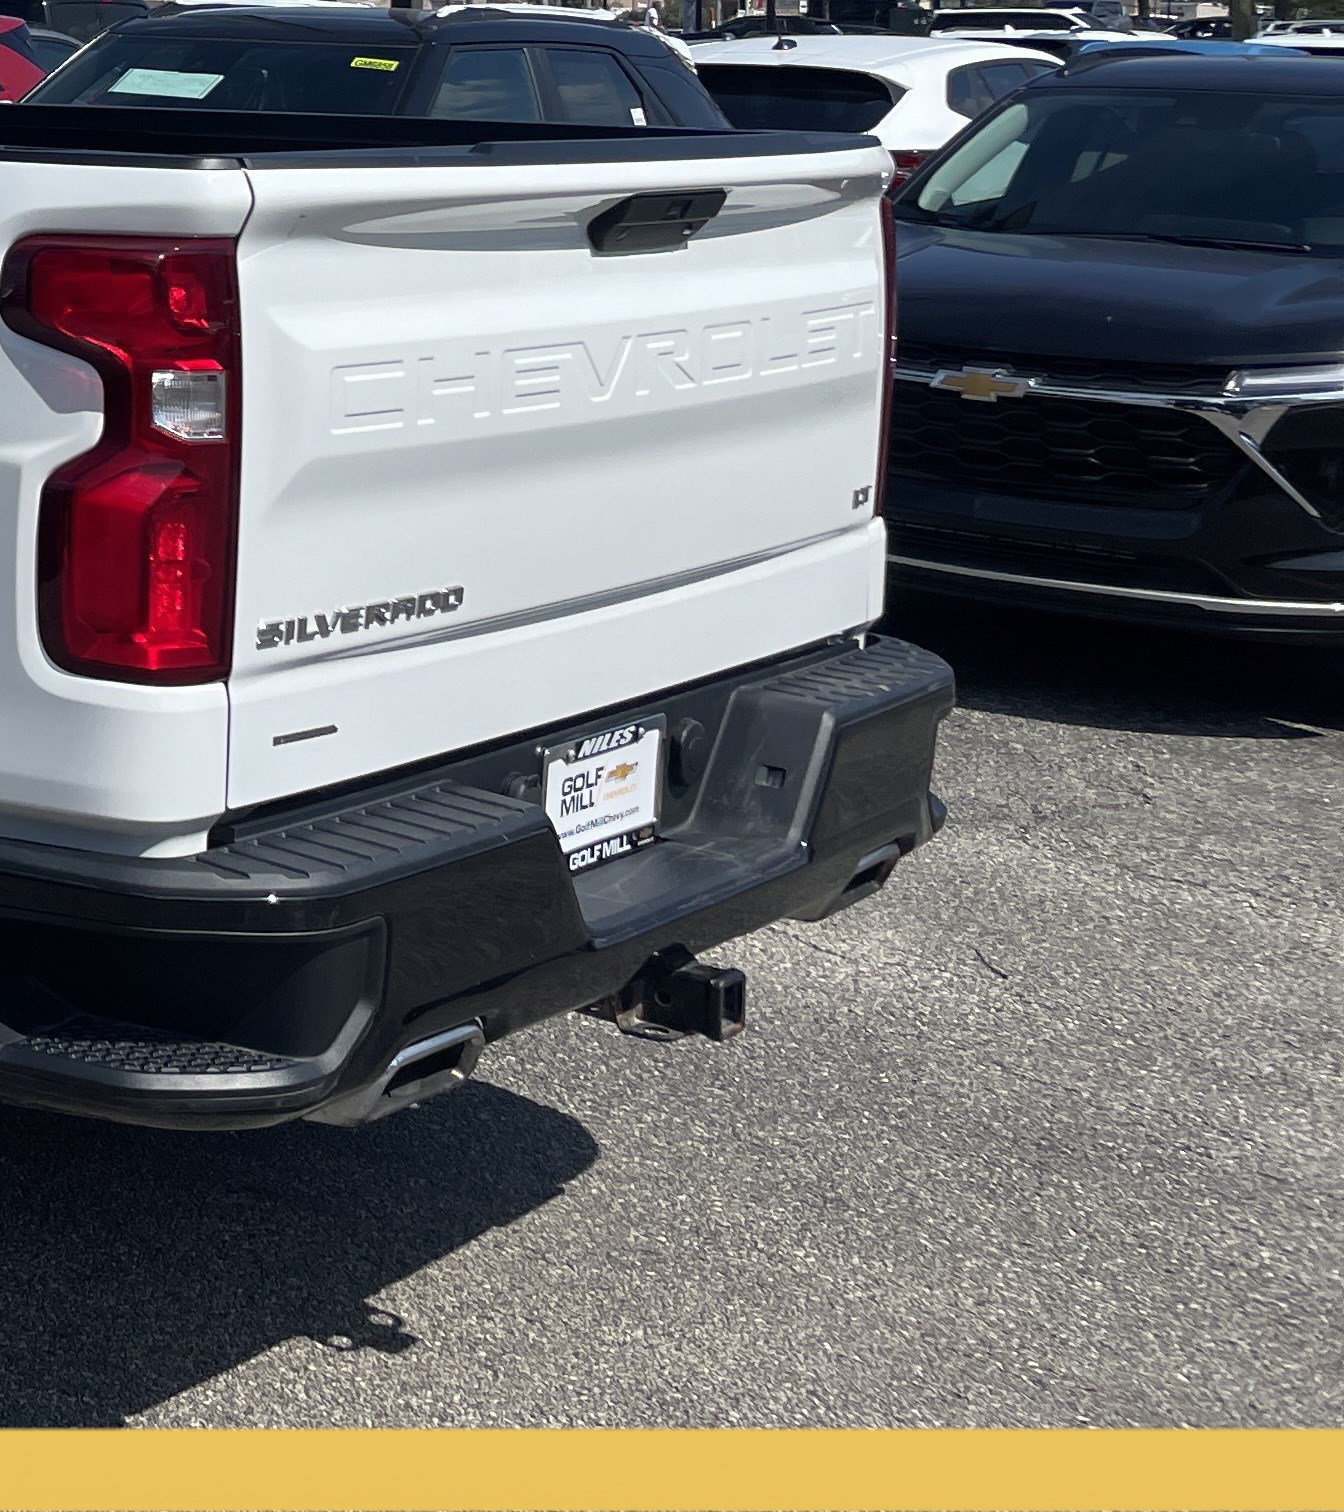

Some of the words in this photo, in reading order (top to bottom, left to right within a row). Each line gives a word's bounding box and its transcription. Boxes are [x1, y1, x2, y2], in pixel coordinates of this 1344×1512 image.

[330, 301, 875, 434] CHEVROLET
[255, 586, 465, 650] SILVERADO
[577, 725, 636, 759] NILES
[562, 765, 605, 797] GOLF
[560, 790, 595, 818] MILL
[569, 843, 602, 871] GOLF
[602, 834, 632, 859] MILL
